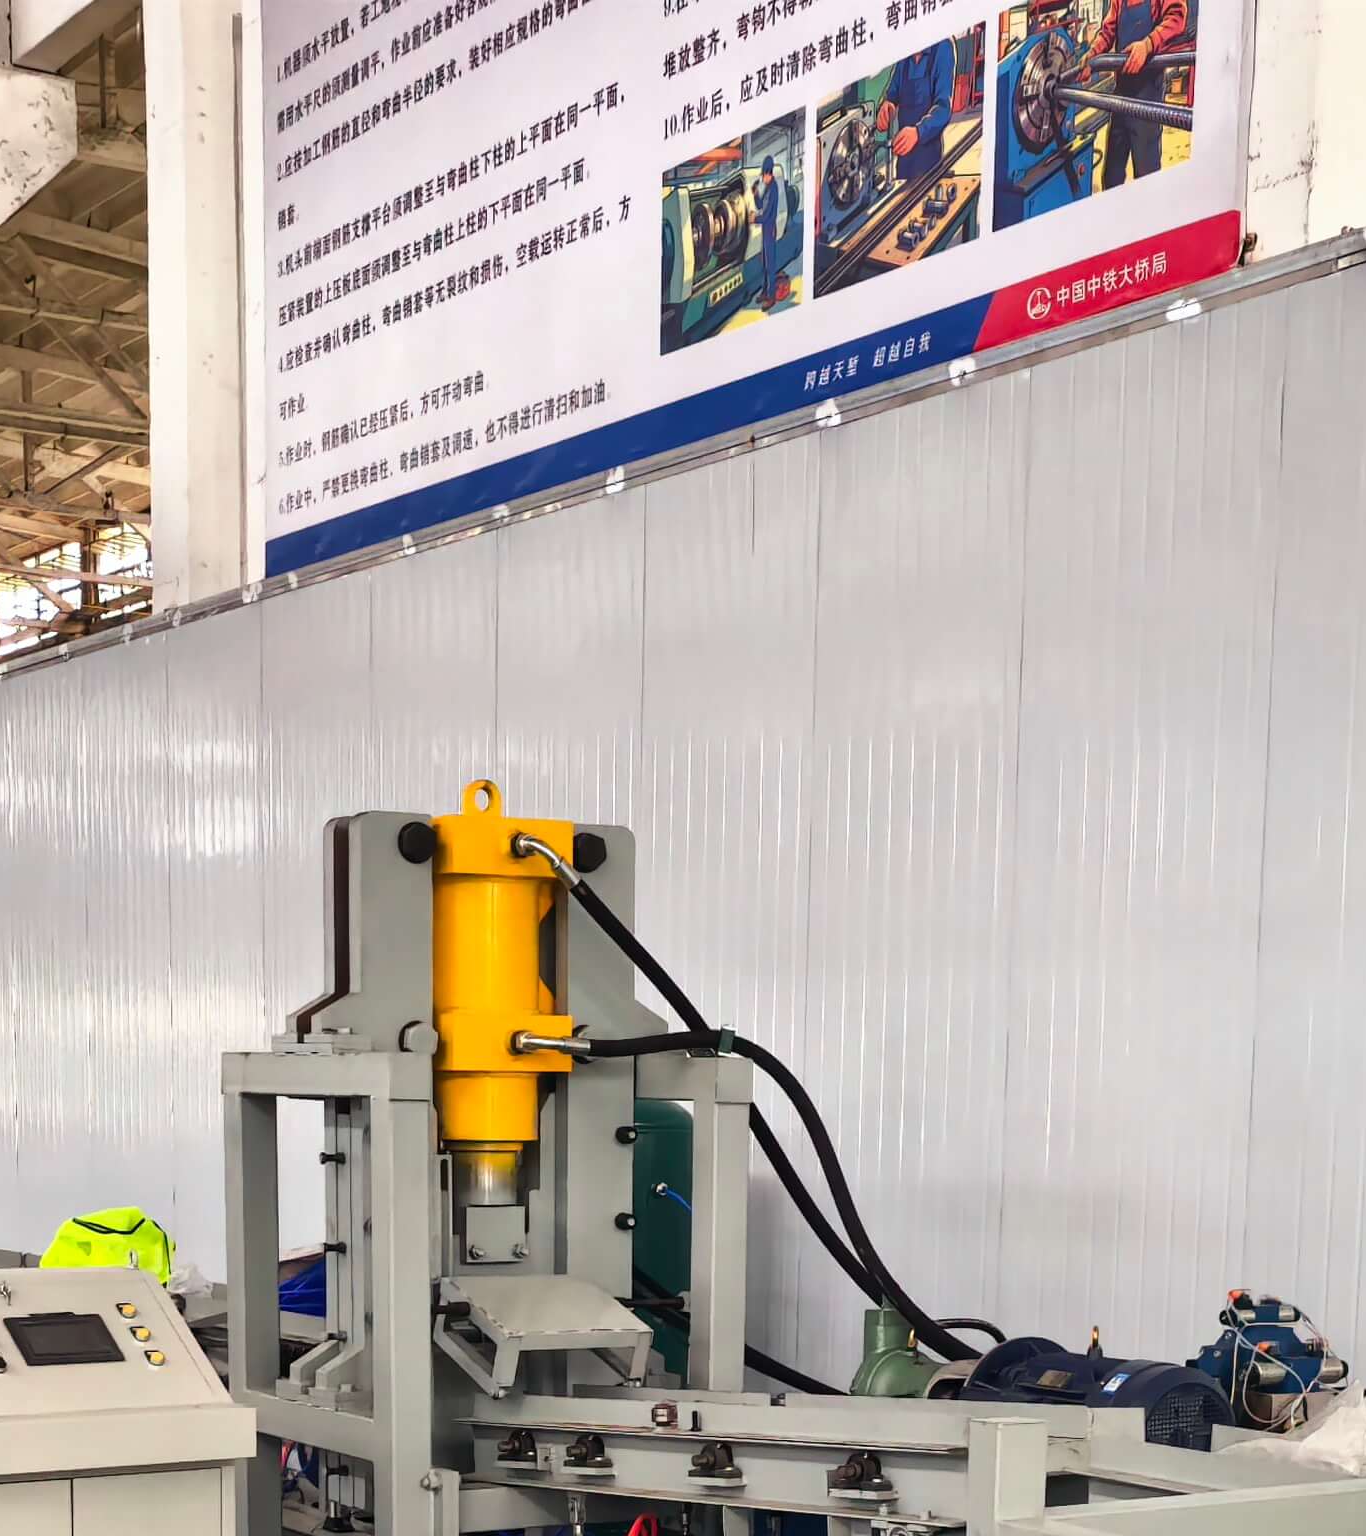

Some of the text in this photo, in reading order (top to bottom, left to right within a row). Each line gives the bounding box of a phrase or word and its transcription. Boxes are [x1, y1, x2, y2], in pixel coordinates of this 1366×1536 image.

[1056, 251, 1168, 307] 中国中铁大桥局
[873, 331, 931, 368] 超越自我
